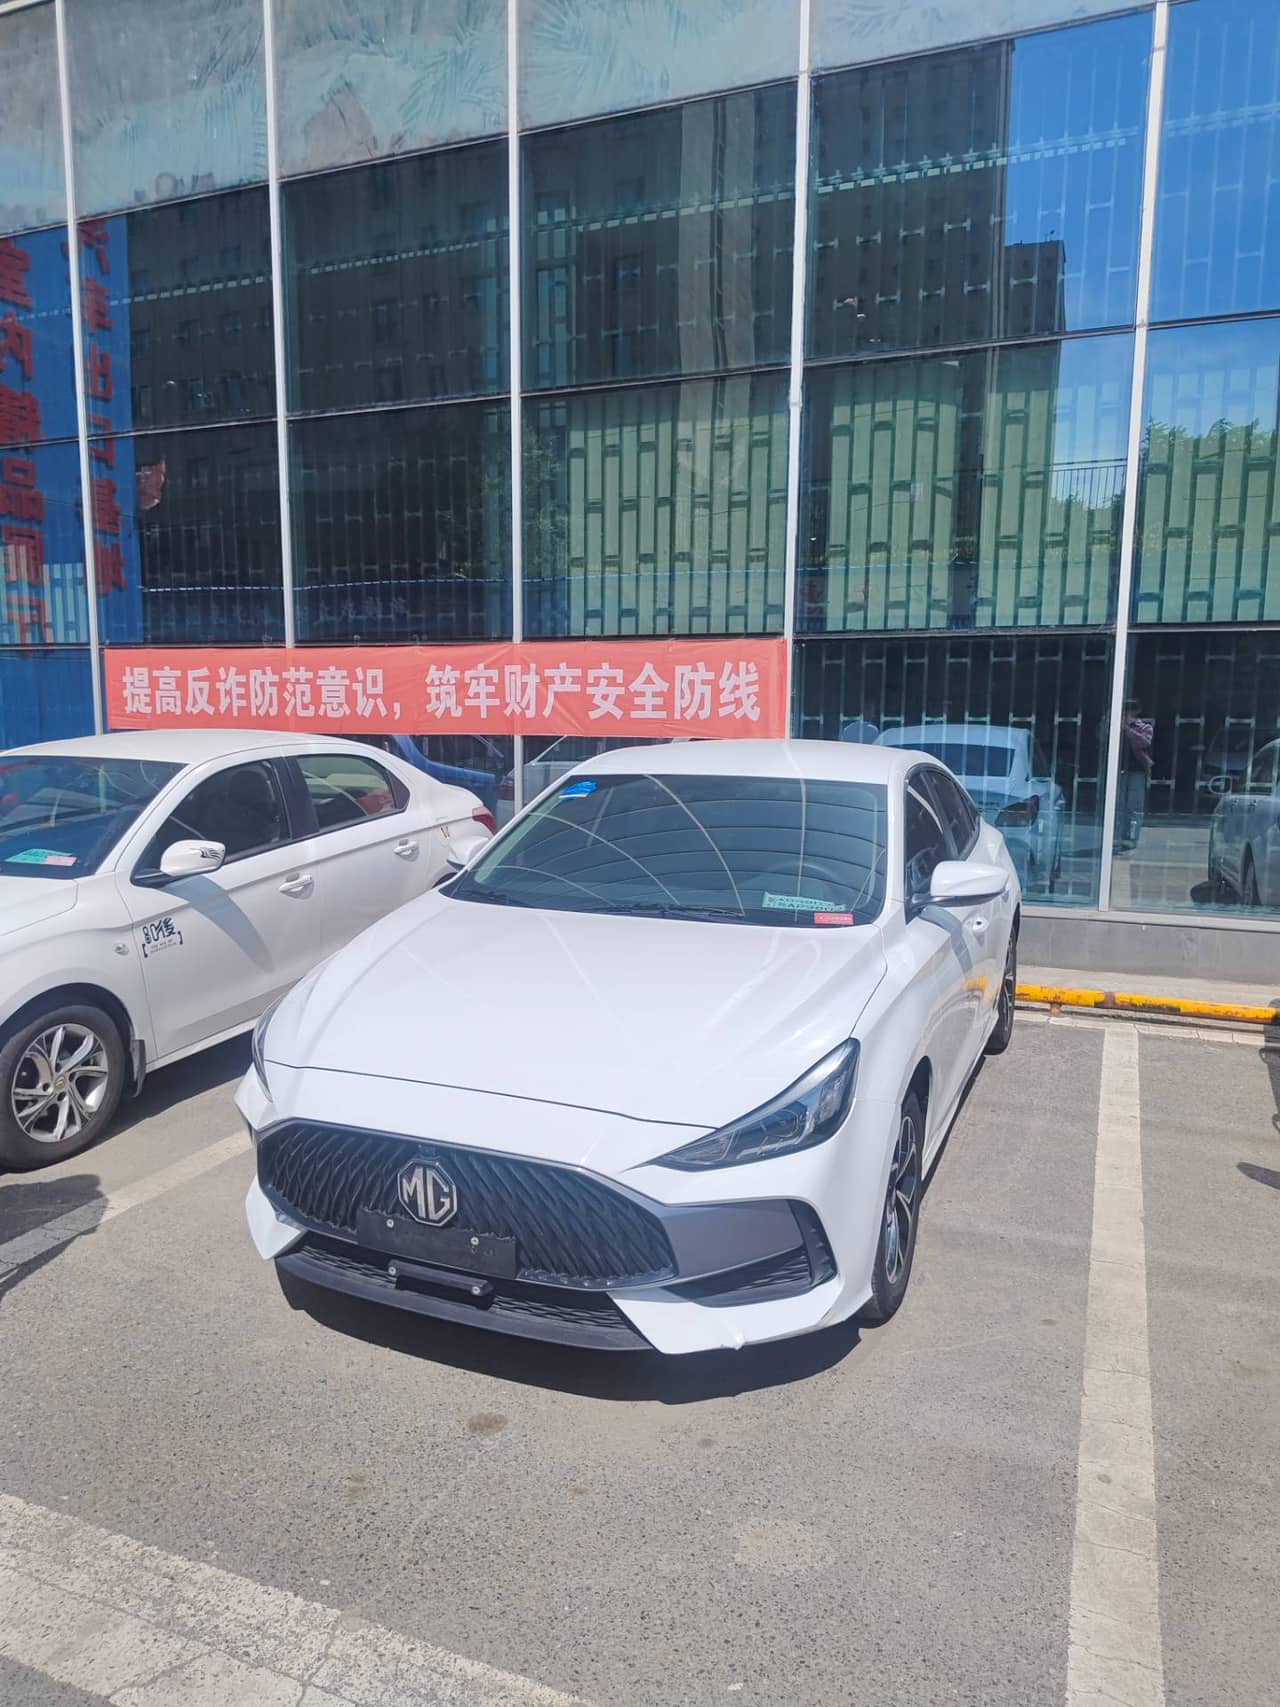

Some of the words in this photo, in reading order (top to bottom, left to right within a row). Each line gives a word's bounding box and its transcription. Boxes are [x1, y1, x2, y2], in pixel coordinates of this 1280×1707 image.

[122, 661, 761, 721] 提高反诈防范意识，筑牢财产安全防线
[402, 1167, 451, 1219] MG
